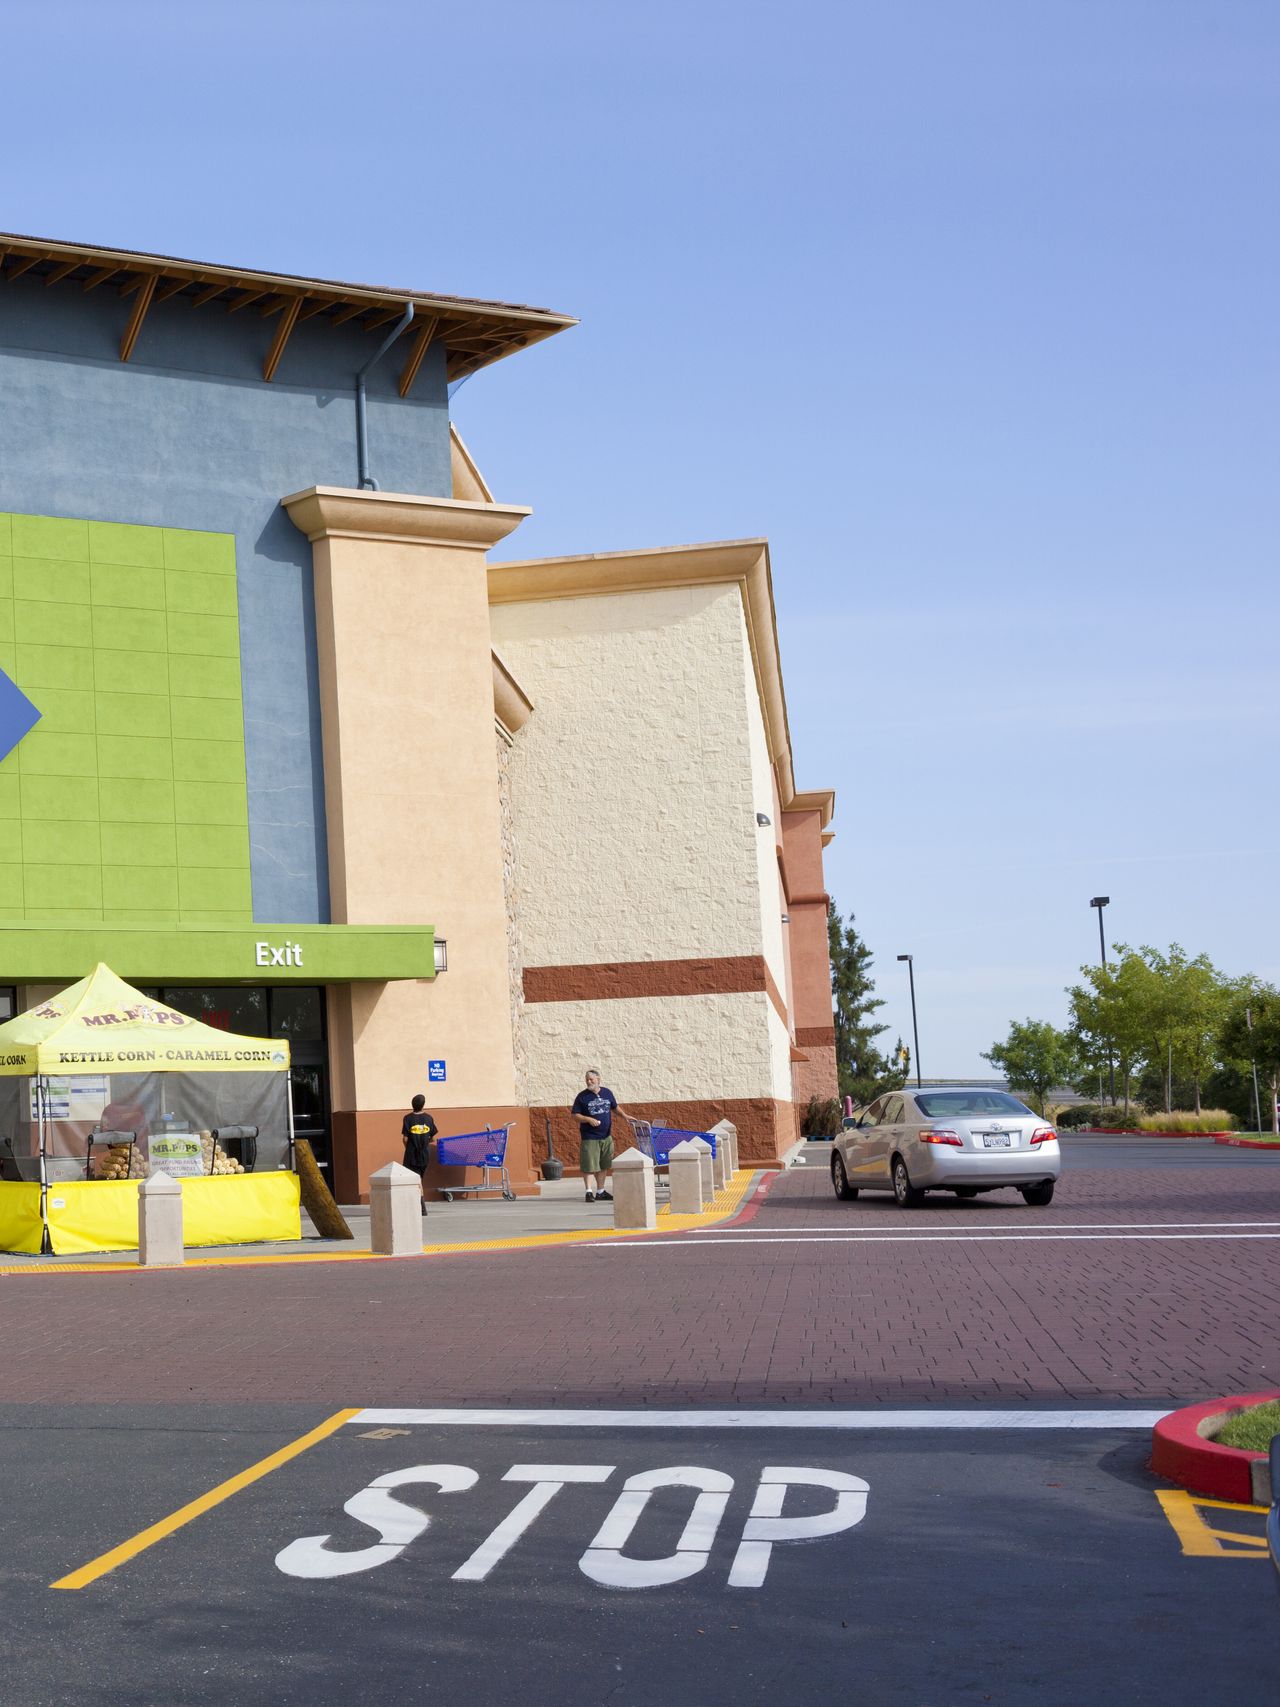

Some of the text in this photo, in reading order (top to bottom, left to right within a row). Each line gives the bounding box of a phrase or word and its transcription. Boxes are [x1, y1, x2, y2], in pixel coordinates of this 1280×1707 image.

[255, 941, 304, 966] Exit
[6, 1054, 26, 1065] CORN
[60, 1051, 114, 1063] KETTLE
[117, 1051, 155, 1061] CORN
[166, 1050, 231, 1060] CARAMEL
[234, 1051, 271, 1061] CORN
[275, 1464, 870, 1588] STOP
